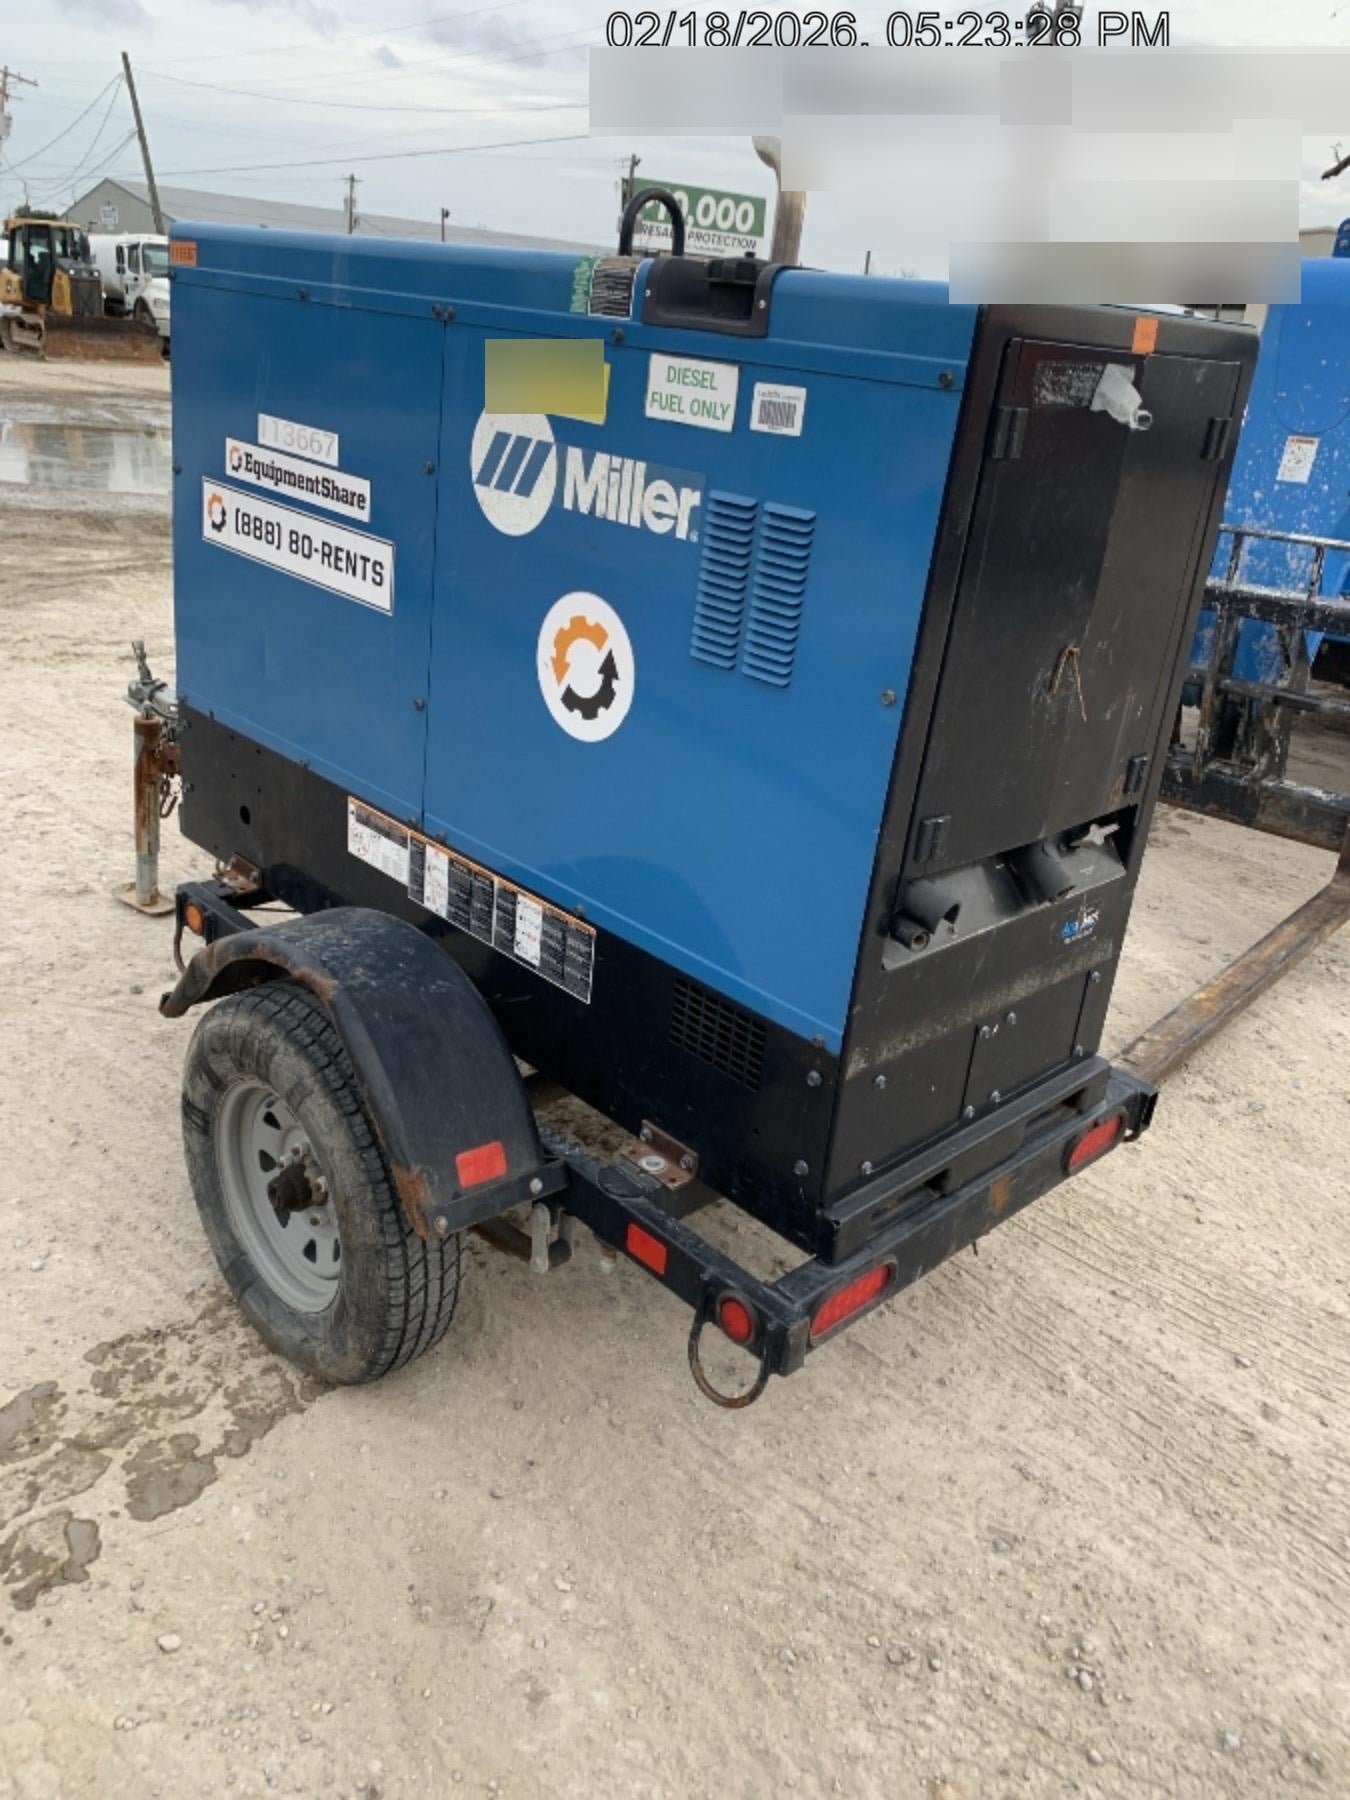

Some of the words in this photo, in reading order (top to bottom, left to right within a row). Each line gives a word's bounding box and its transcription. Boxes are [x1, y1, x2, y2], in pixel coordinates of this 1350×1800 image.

[688, 230, 757, 250] PROTECTION
[667, 365, 718, 390] DIESEL
[649, 391, 685, 414] FUEL
[690, 398, 730, 420] ONLY
[261, 416, 336, 458] 113667
[244, 452, 365, 510] EquipmentShare
[563, 445, 701, 541] Miller
[235, 508, 282, 551] (888)
[289, 529, 384, 587] 80-RENTS
